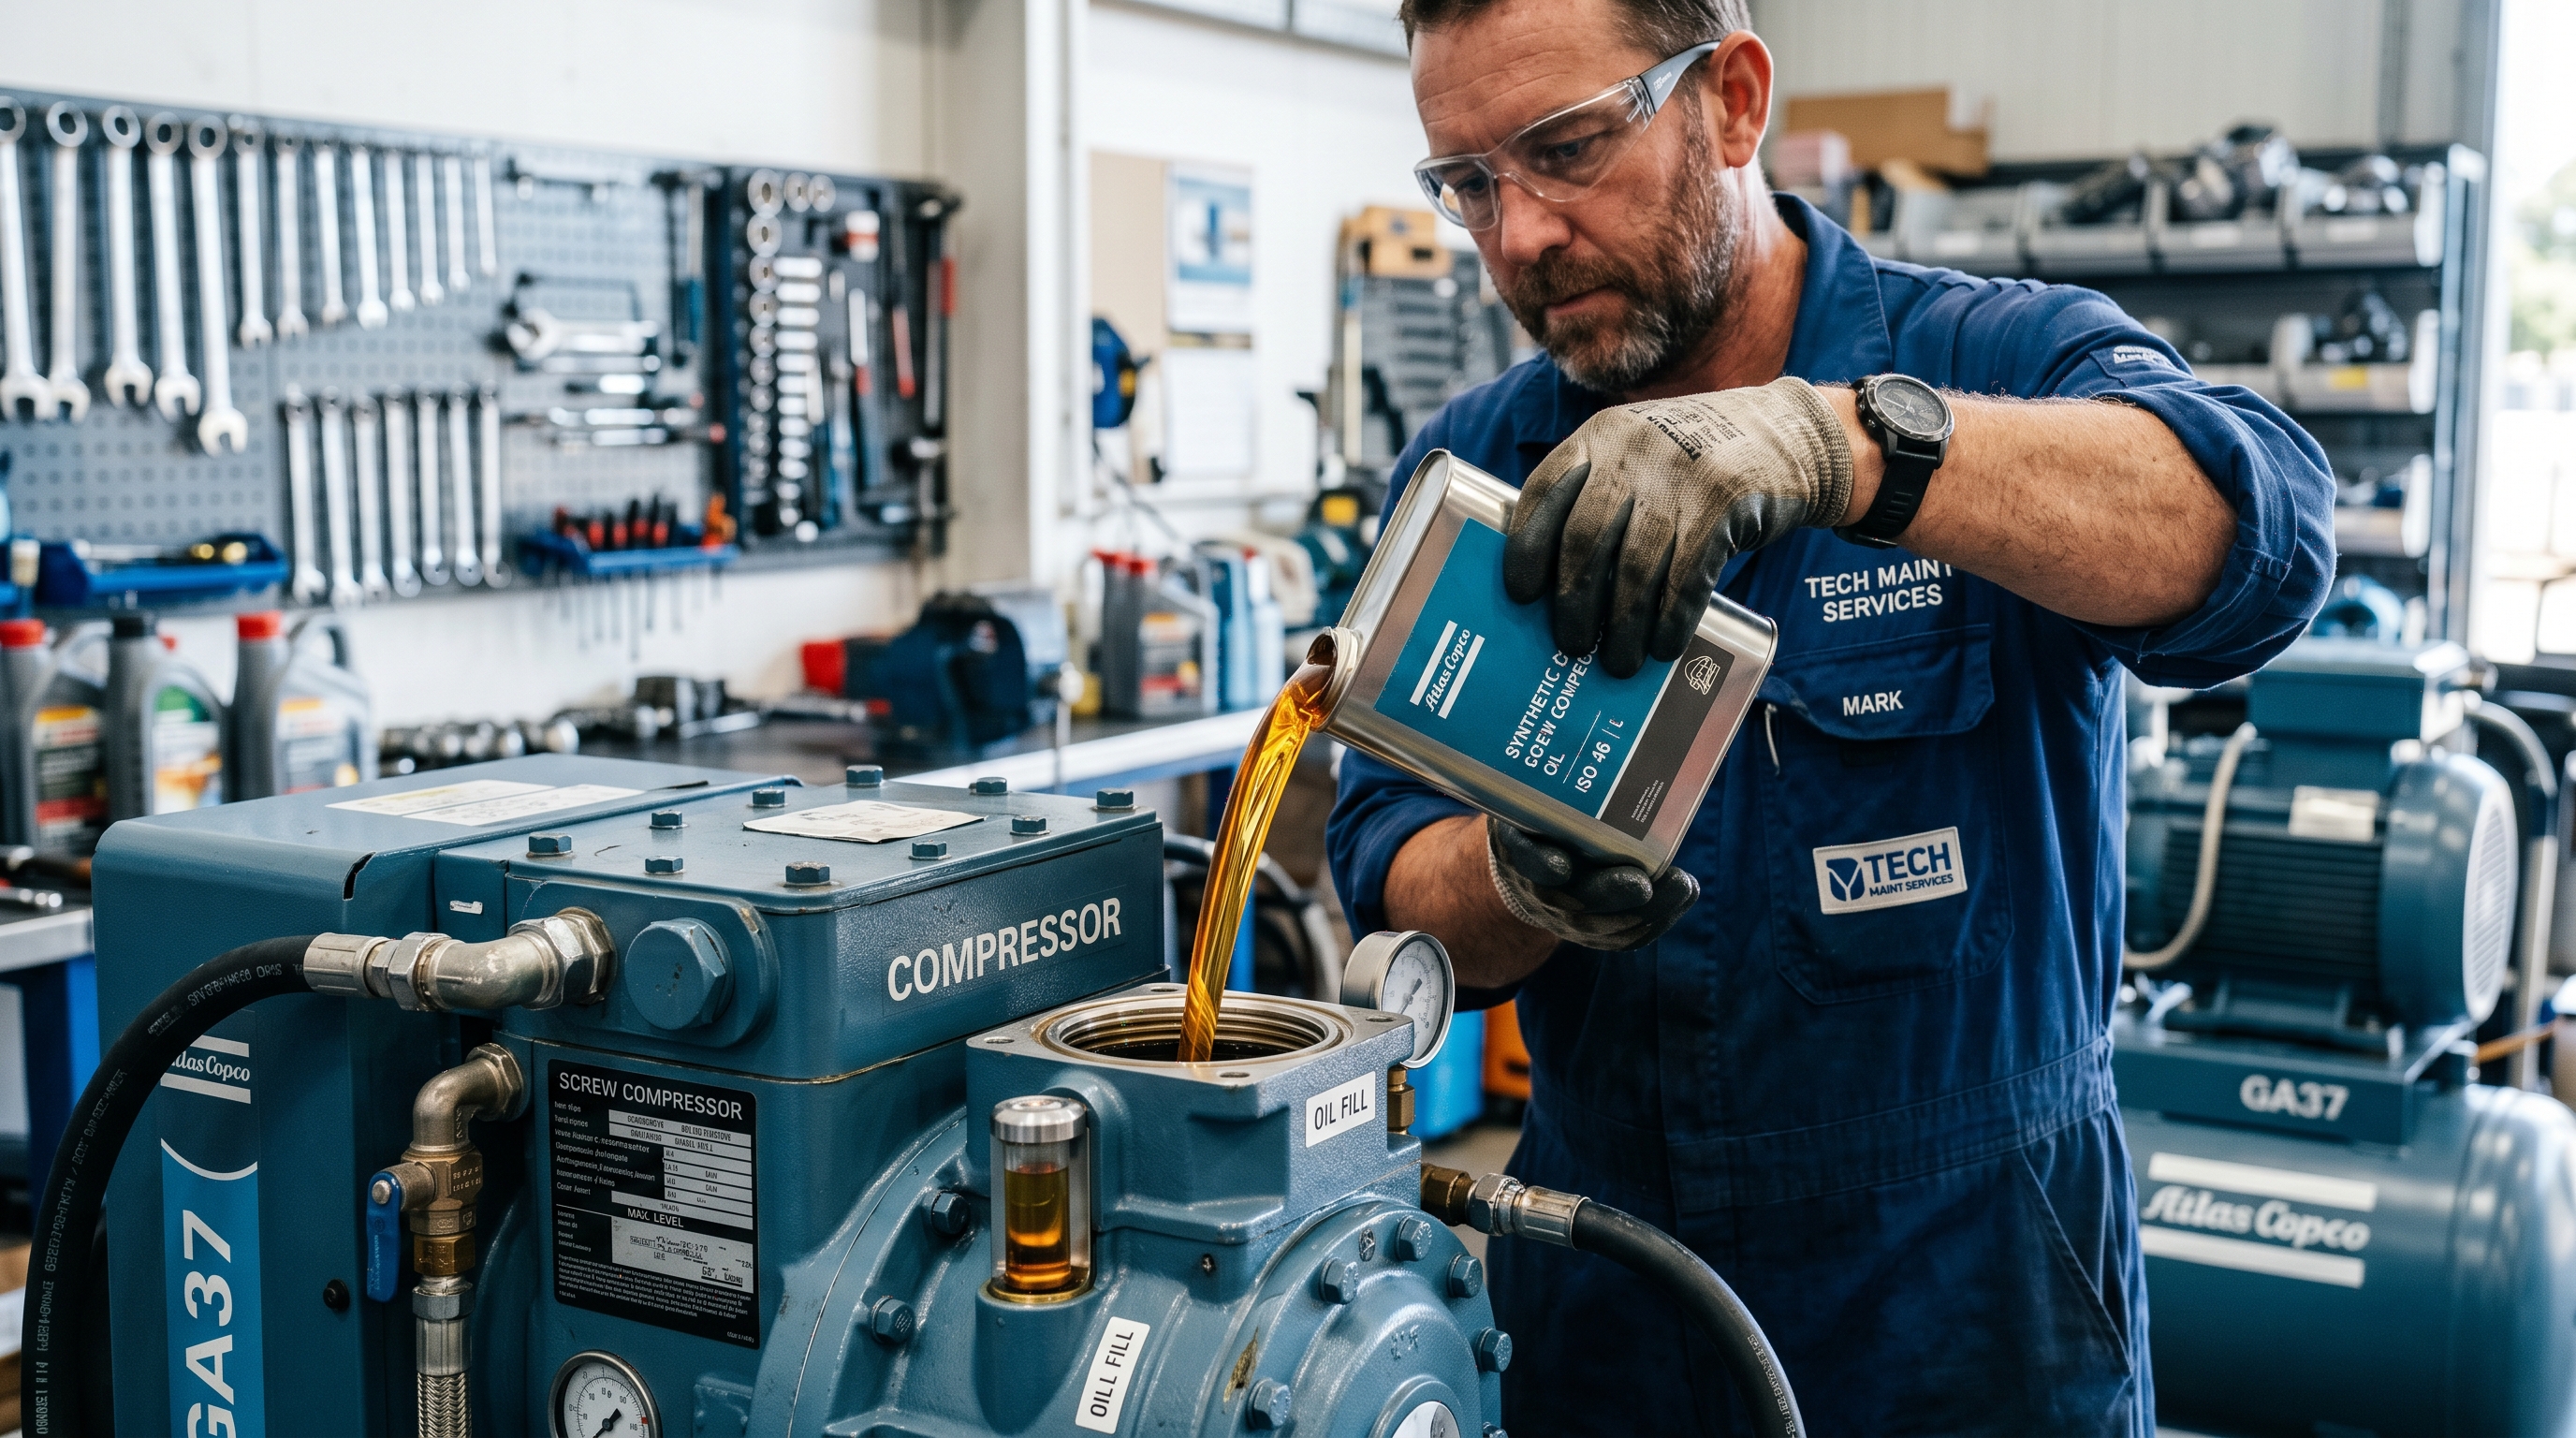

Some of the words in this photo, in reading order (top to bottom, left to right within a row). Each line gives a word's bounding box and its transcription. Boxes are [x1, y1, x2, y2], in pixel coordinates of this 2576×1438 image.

[1805, 570, 1869, 598] TECH
[1823, 584, 1942, 623] SERVICES
[1426, 669, 1452, 712] Atlas
[1444, 629, 1471, 670] Copco
[1505, 668, 1560, 759] SYNTHETIC
[1843, 690, 1904, 716] MARK
[1574, 765, 1598, 793] ISO
[1591, 741, 1611, 763] 46
[1864, 842, 1952, 883] TECH
[1869, 883, 1903, 897] MAINT
[1906, 873, 1954, 891] SERVICES
[887, 897, 1121, 1002] COMPRESSOR
[206, 1055, 251, 1081] Copco
[559, 1072, 617, 1098] SCREW
[622, 1082, 743, 1121] COMPRESSOR
[1314, 1102, 1336, 1130] OIL
[1341, 1089, 1368, 1119] FILL
[2239, 1074, 2350, 1122] GA37
[653, 1212, 684, 1228] LEVEL
[2141, 1184, 2254, 1235] Atlas
[2254, 1200, 2371, 1252] Copco
[1105, 1331, 1134, 1368] FILL
